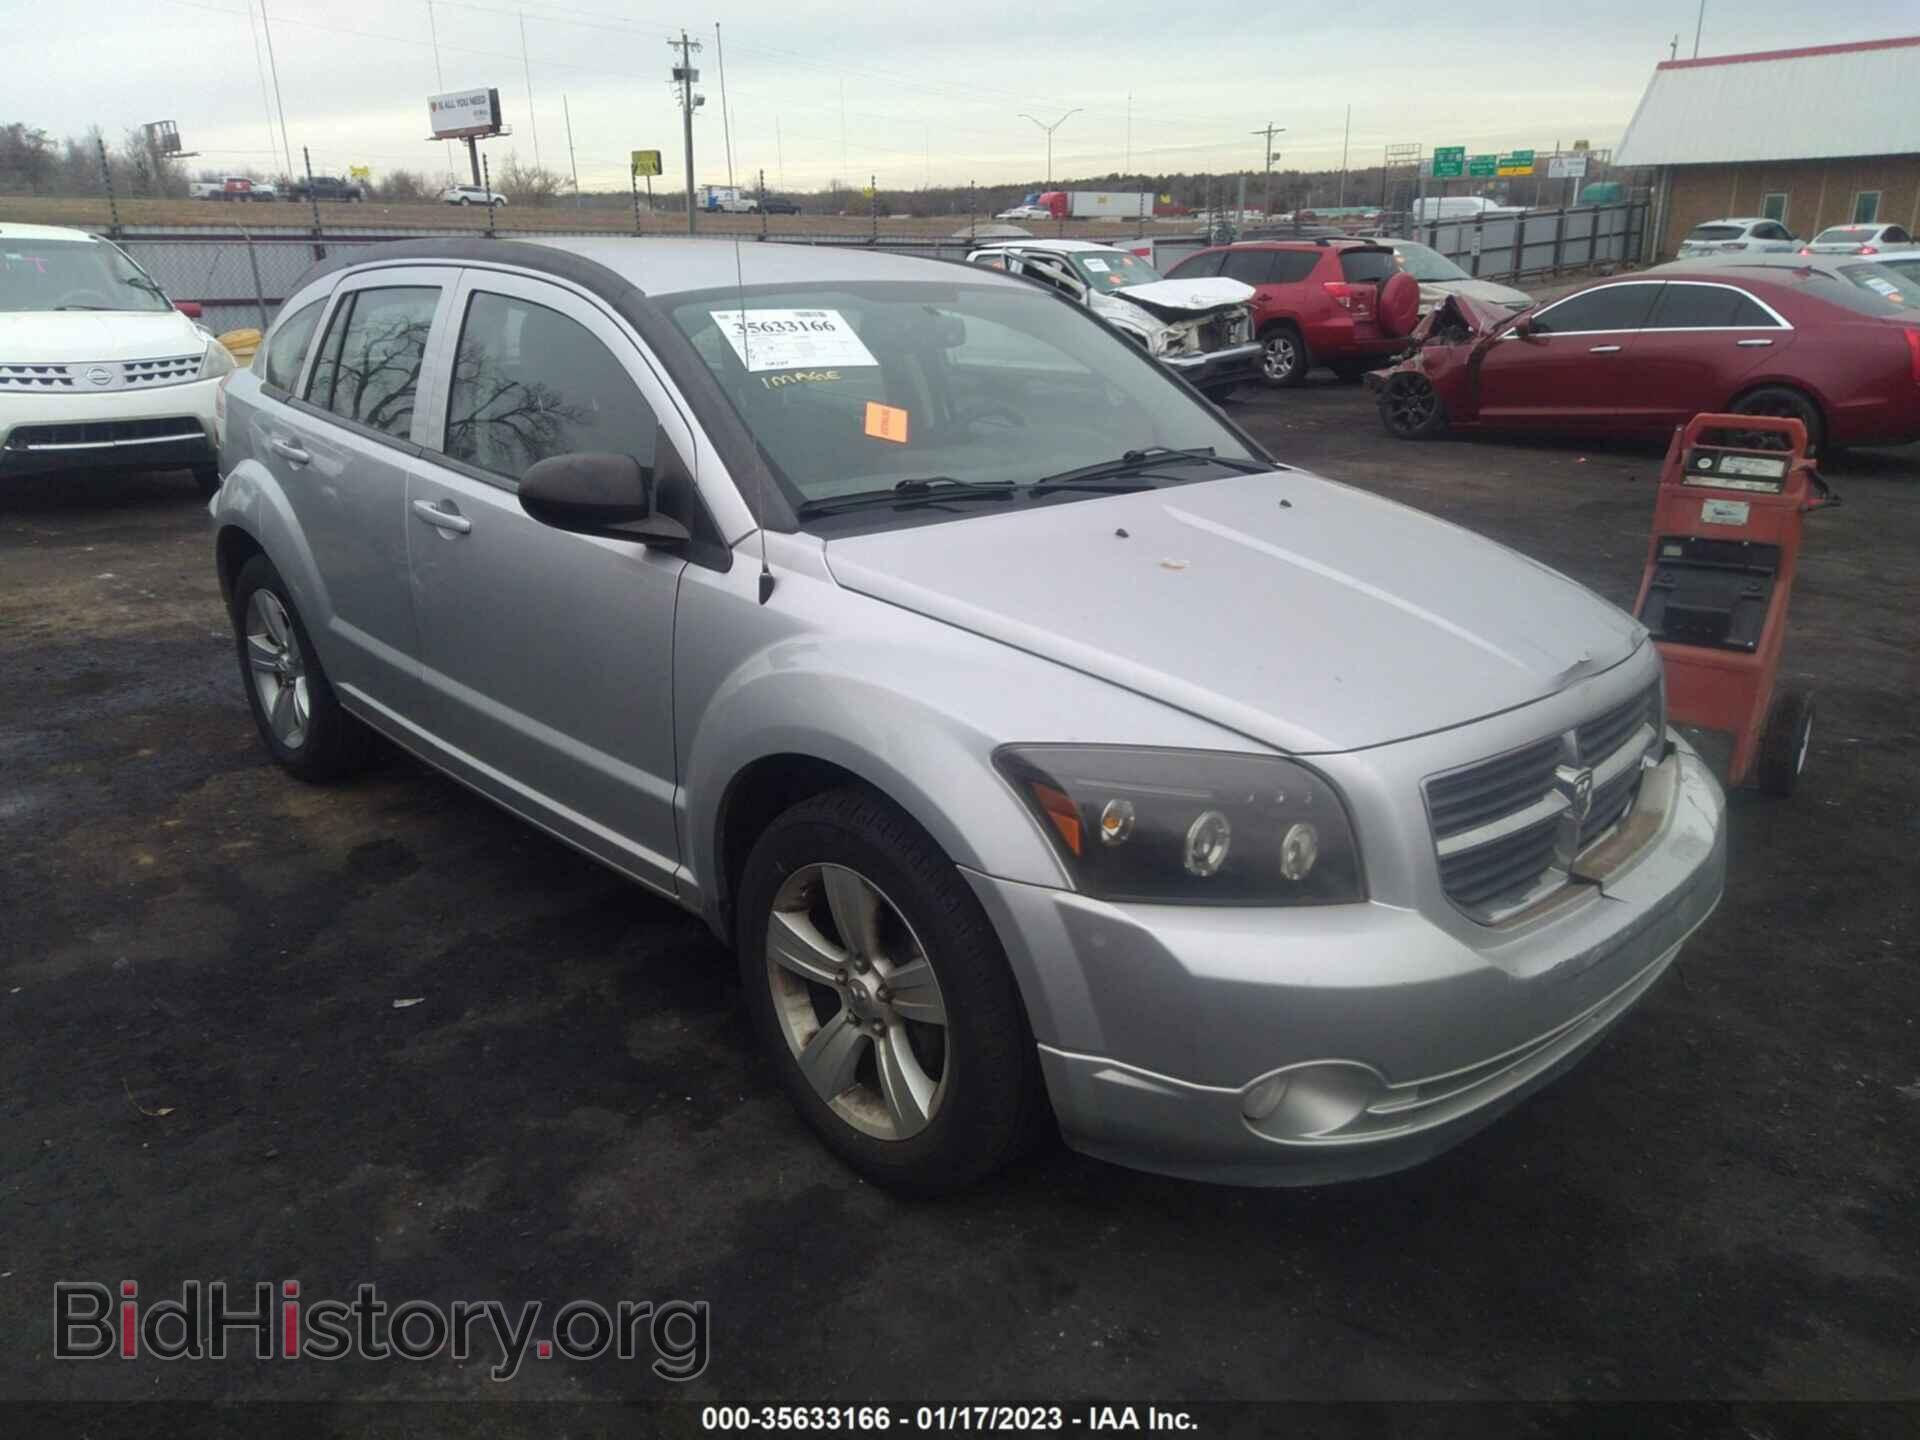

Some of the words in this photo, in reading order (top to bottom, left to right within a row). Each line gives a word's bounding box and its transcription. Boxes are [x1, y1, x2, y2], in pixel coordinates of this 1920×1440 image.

[445, 99, 456, 109] ALL
[456, 97, 469, 107] YOU
[469, 95, 486, 105] NEED
[733, 320, 837, 336] 35633166
